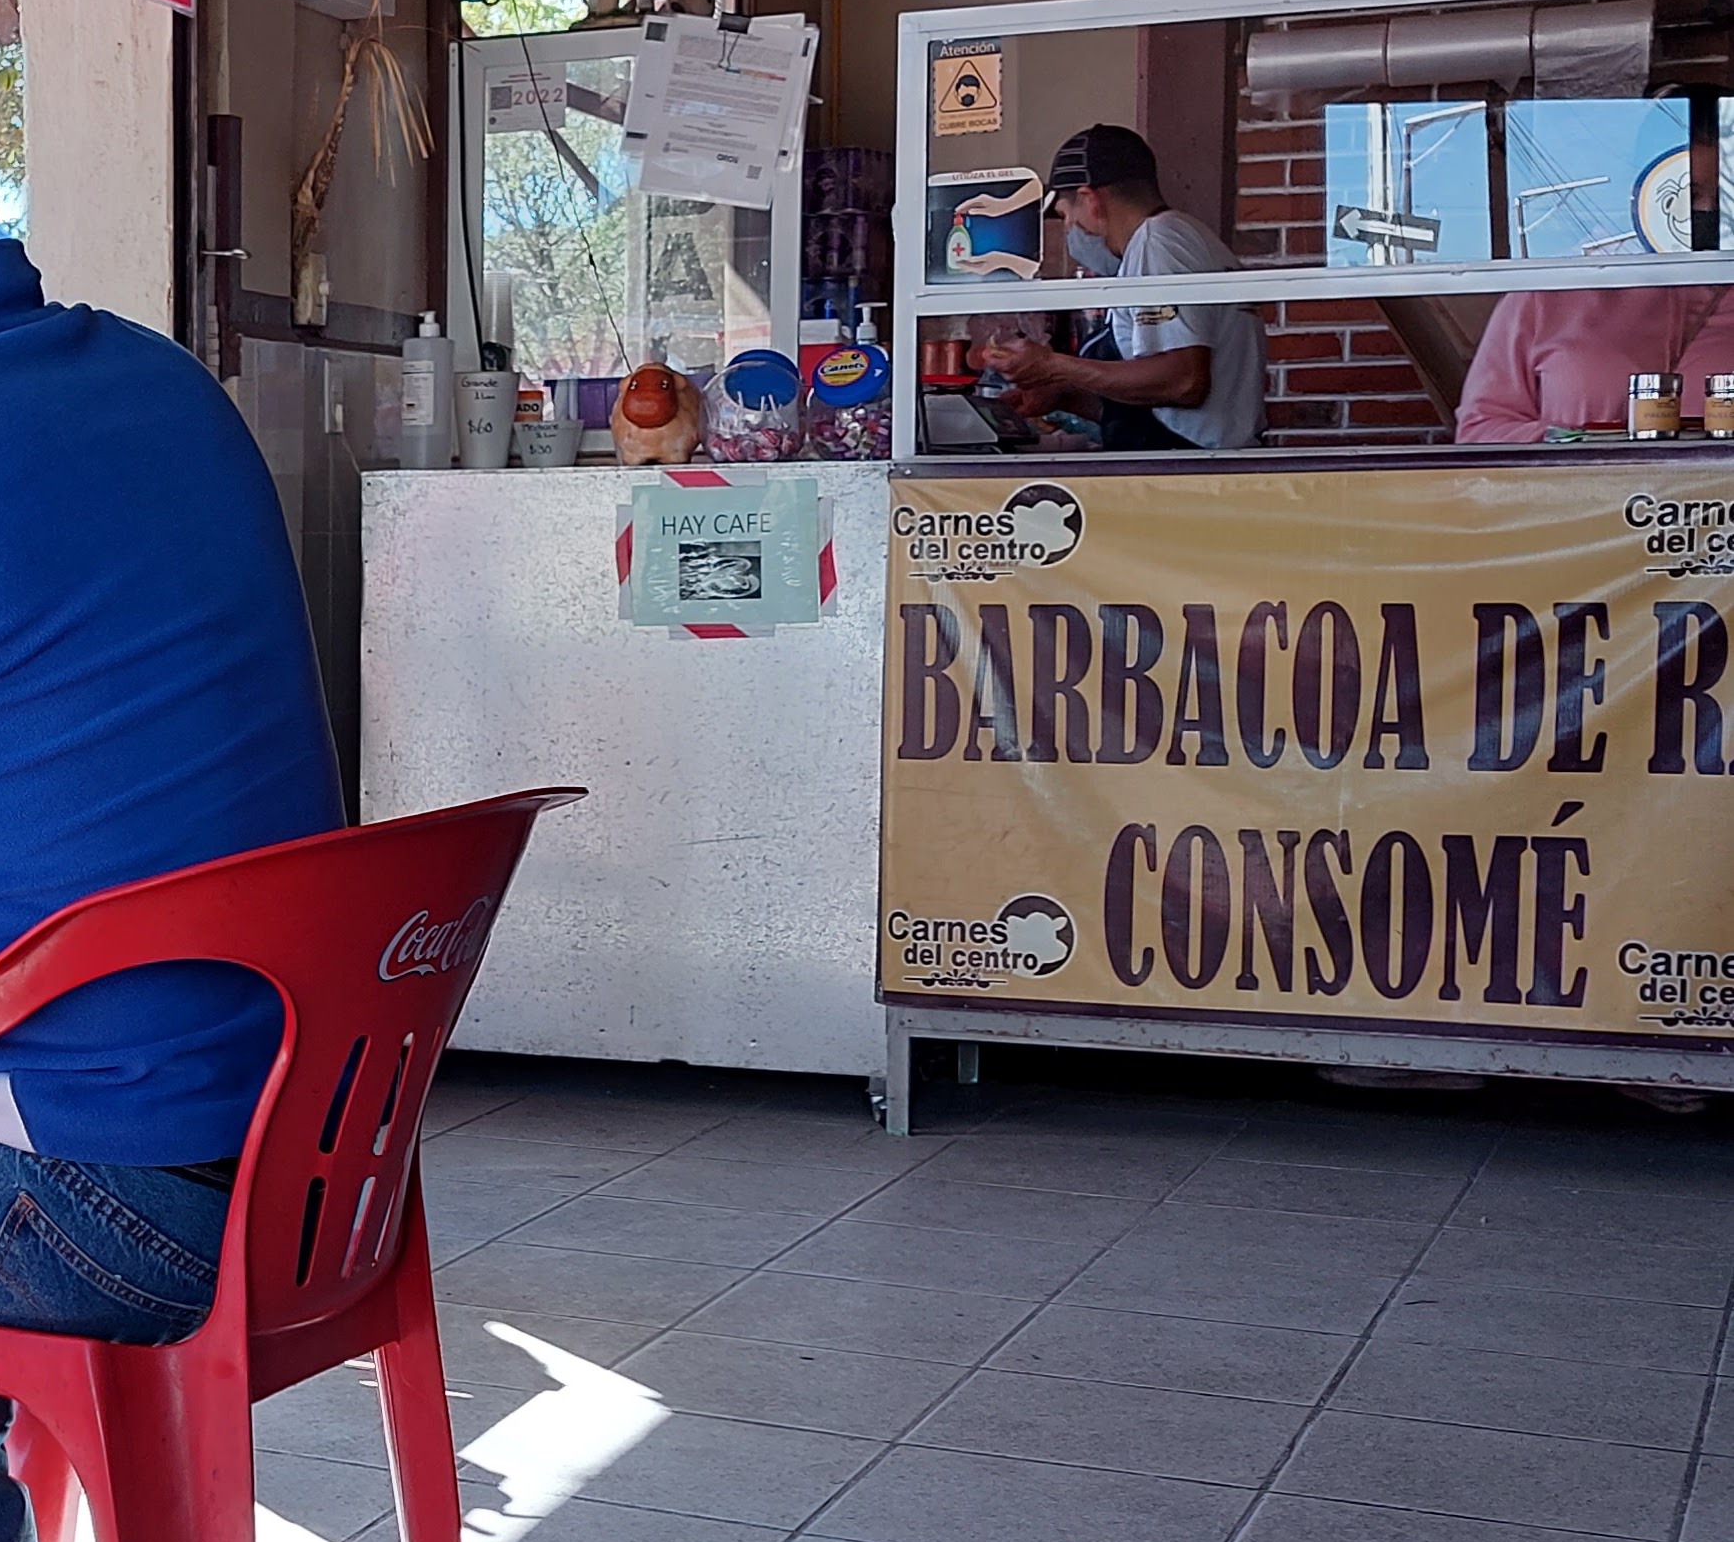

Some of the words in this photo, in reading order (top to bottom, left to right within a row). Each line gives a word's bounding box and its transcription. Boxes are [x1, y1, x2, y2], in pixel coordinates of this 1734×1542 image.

[939, 42, 996, 58] Atención
[513, 87, 563, 106] 2022
[938, 120, 966, 131] CUBRE
[968, 118, 997, 128] BOCAS
[661, 515, 707, 536] HAY
[713, 512, 773, 535] CAFE
[893, 506, 1015, 537] Carnes
[909, 537, 948, 560] del
[957, 538, 1046, 560] centro
[1646, 527, 1696, 554] del
[897, 600, 1430, 771] BARBACOA
[1467, 600, 1611, 775] DE
[1646, 600, 1734, 775] R
[1103, 800, 1592, 1009] CONSOMÉ
[887, 911, 1009, 944] Carnes
[903, 943, 942, 966] del
[951, 947, 1039, 970] centro
[1639, 977, 1687, 1003] del
